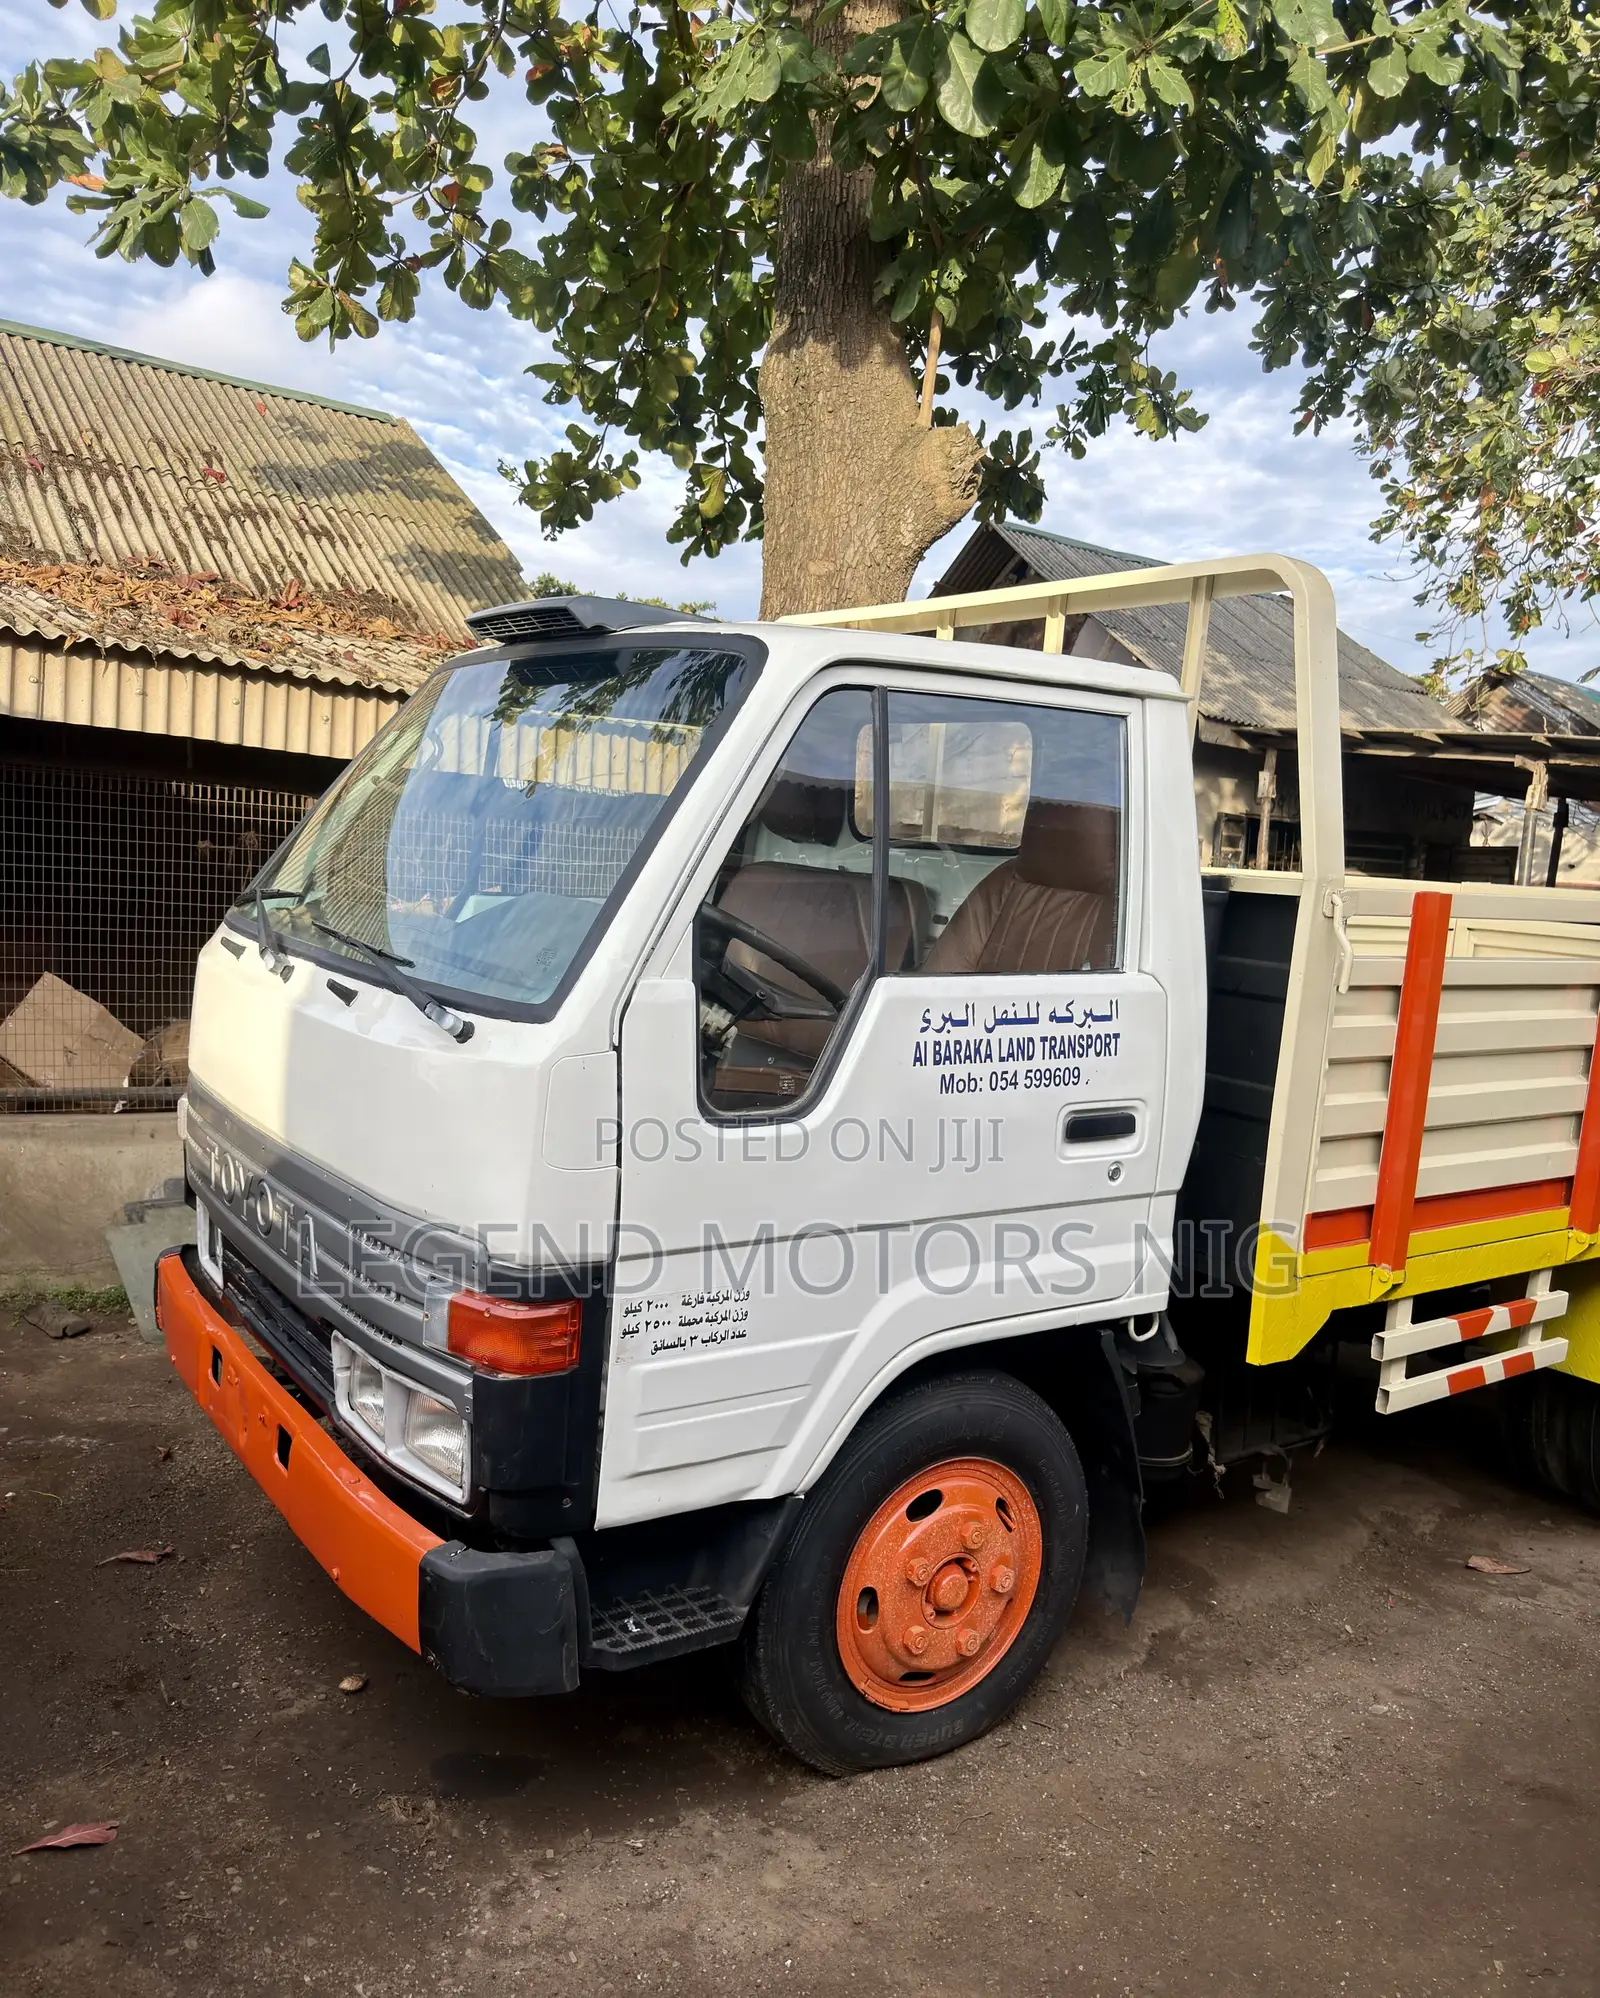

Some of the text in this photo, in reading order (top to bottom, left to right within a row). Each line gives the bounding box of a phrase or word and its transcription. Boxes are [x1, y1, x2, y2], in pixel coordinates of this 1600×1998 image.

[932, 1037, 994, 1066] BARAKA
[998, 1036, 1036, 1063] LAND
[1040, 1032, 1121, 1061] TRANSPORT
[939, 1066, 1081, 1095] Mob: 054 599609
[205, 1135, 319, 1281] TOYOTA
[681, 1292, 705, 1309] فارغة
[706, 1290, 732, 1307] المركبة
[734, 1287, 750, 1302] وزن
[622, 1301, 643, 1318] كيلو
[732, 1308, 749, 1321] وزن
[678, 1313, 703, 1328] محملة
[705, 1310, 731, 1327] المركبة
[620, 1322, 640, 1339] كيلو
[701, 1329, 729, 1347] الركاب
[731, 1327, 747, 1339] عدد
